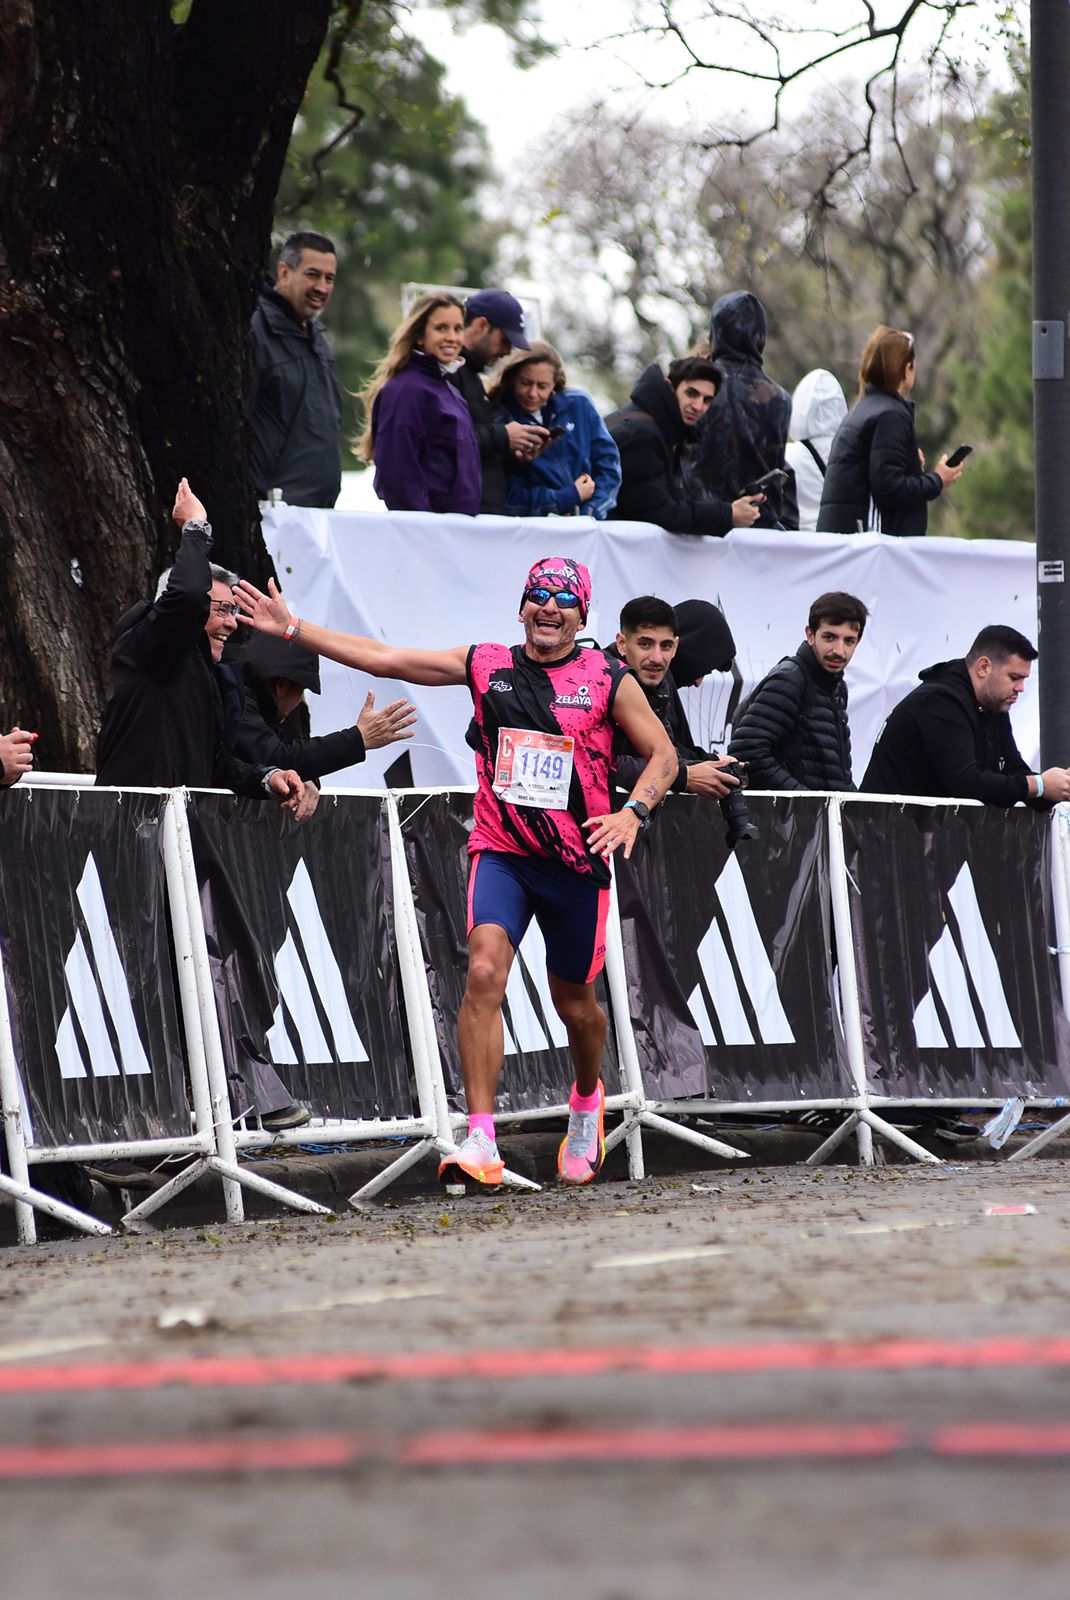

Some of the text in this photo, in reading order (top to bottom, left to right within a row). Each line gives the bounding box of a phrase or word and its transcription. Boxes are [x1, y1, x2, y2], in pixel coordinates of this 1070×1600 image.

[537, 567, 578, 585] ZELAYA
[556, 695, 592, 706] ZELAYA
[502, 735, 512, 757] C
[522, 753, 563, 779] 1149
